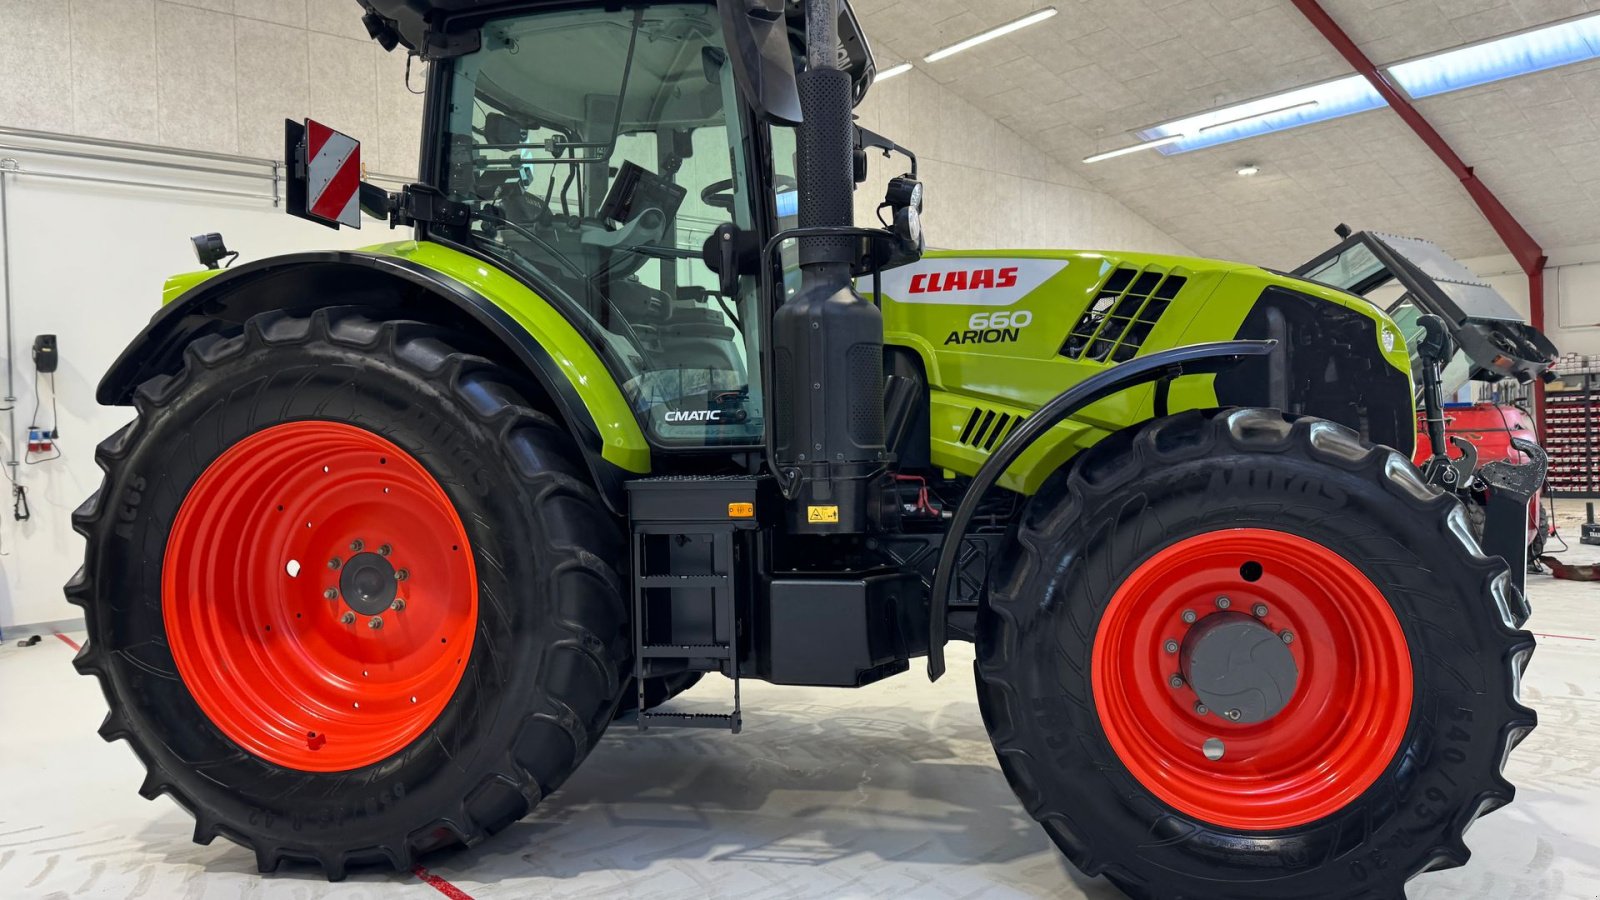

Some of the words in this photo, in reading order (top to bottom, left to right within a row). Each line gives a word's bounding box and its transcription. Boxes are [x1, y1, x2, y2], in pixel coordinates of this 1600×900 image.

[908, 267, 1018, 294] CLAAS
[968, 310, 1032, 330] 660
[943, 328, 1019, 345] ARION
[664, 410, 721, 422] CMATIC
